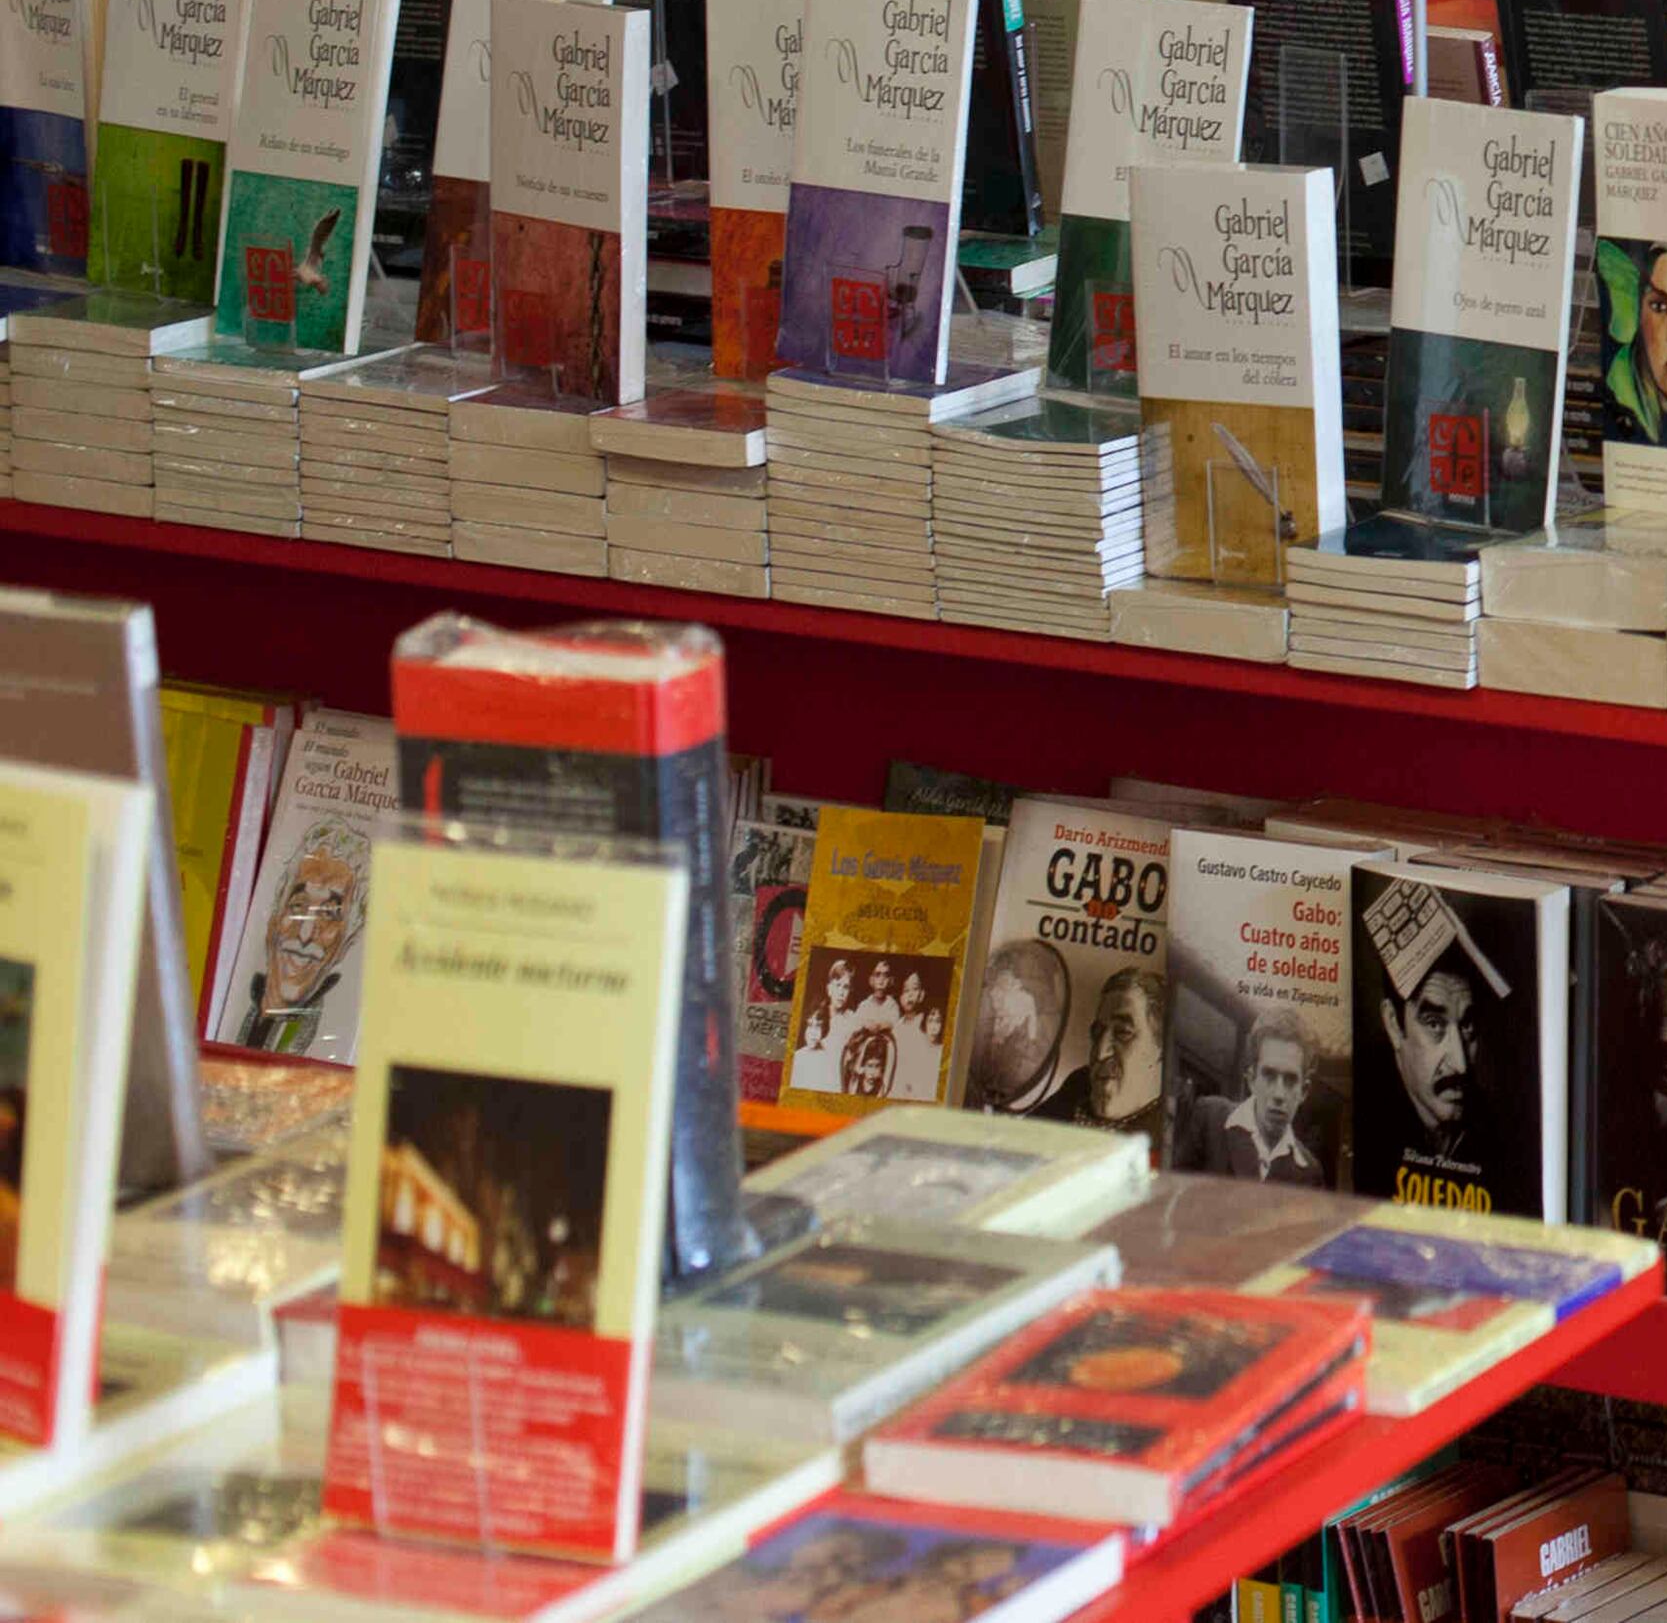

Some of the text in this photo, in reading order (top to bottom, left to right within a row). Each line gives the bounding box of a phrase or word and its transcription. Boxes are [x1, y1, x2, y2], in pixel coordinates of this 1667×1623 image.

[159, 21, 223, 65] Márquez
[310, 33, 361, 68] García
[552, 30, 611, 78] Gabriel
[884, 39, 948, 76] García
[1158, 25, 1231, 73] Gabriel
[292, 65, 357, 108] Márquez
[557, 72, 612, 109] García
[864, 75, 945, 120] Márquez
[1160, 68, 1226, 106] García
[542, 106, 611, 152] Márquez
[1139, 104, 1222, 150] Márquez
[1604, 122, 1641, 143] CIEN
[847, 137, 940, 164] Los de la
[1483, 134, 1556, 186] Gabriel
[900, 163, 939, 183] Grande
[1486, 179, 1554, 218] García
[1214, 198, 1289, 244] Gabriel
[1466, 215, 1551, 264] Márquez
[1222, 244, 1293, 280] García
[1206, 281, 1295, 325] Márquez
[1480, 293, 1546, 319] de azul
[1168, 344, 1249, 365] El amor en los
[1242, 369, 1260, 386] del
[294, 776, 340, 801] García
[333, 760, 390, 787] Gabriel
[1054, 823, 1093, 846] Darío
[831, 847, 858, 875] Los
[1197, 856, 1342, 893] Gustavo Castro Caycedo
[1045, 847, 1167, 914] GABO
[1291, 900, 1343, 927] Gabo:
[1038, 911, 1158, 957] contado
[1240, 922, 1340, 955] Cuatro años
[1246, 950, 1339, 984] de soledad
[1237, 978, 1251, 995] Su
[1253, 980, 1275, 998] vida
[1277, 988, 1290, 1001] en
[1393, 1167, 1492, 1216] SOLEDAD
[1538, 1523, 1593, 1577] GABRIEL
